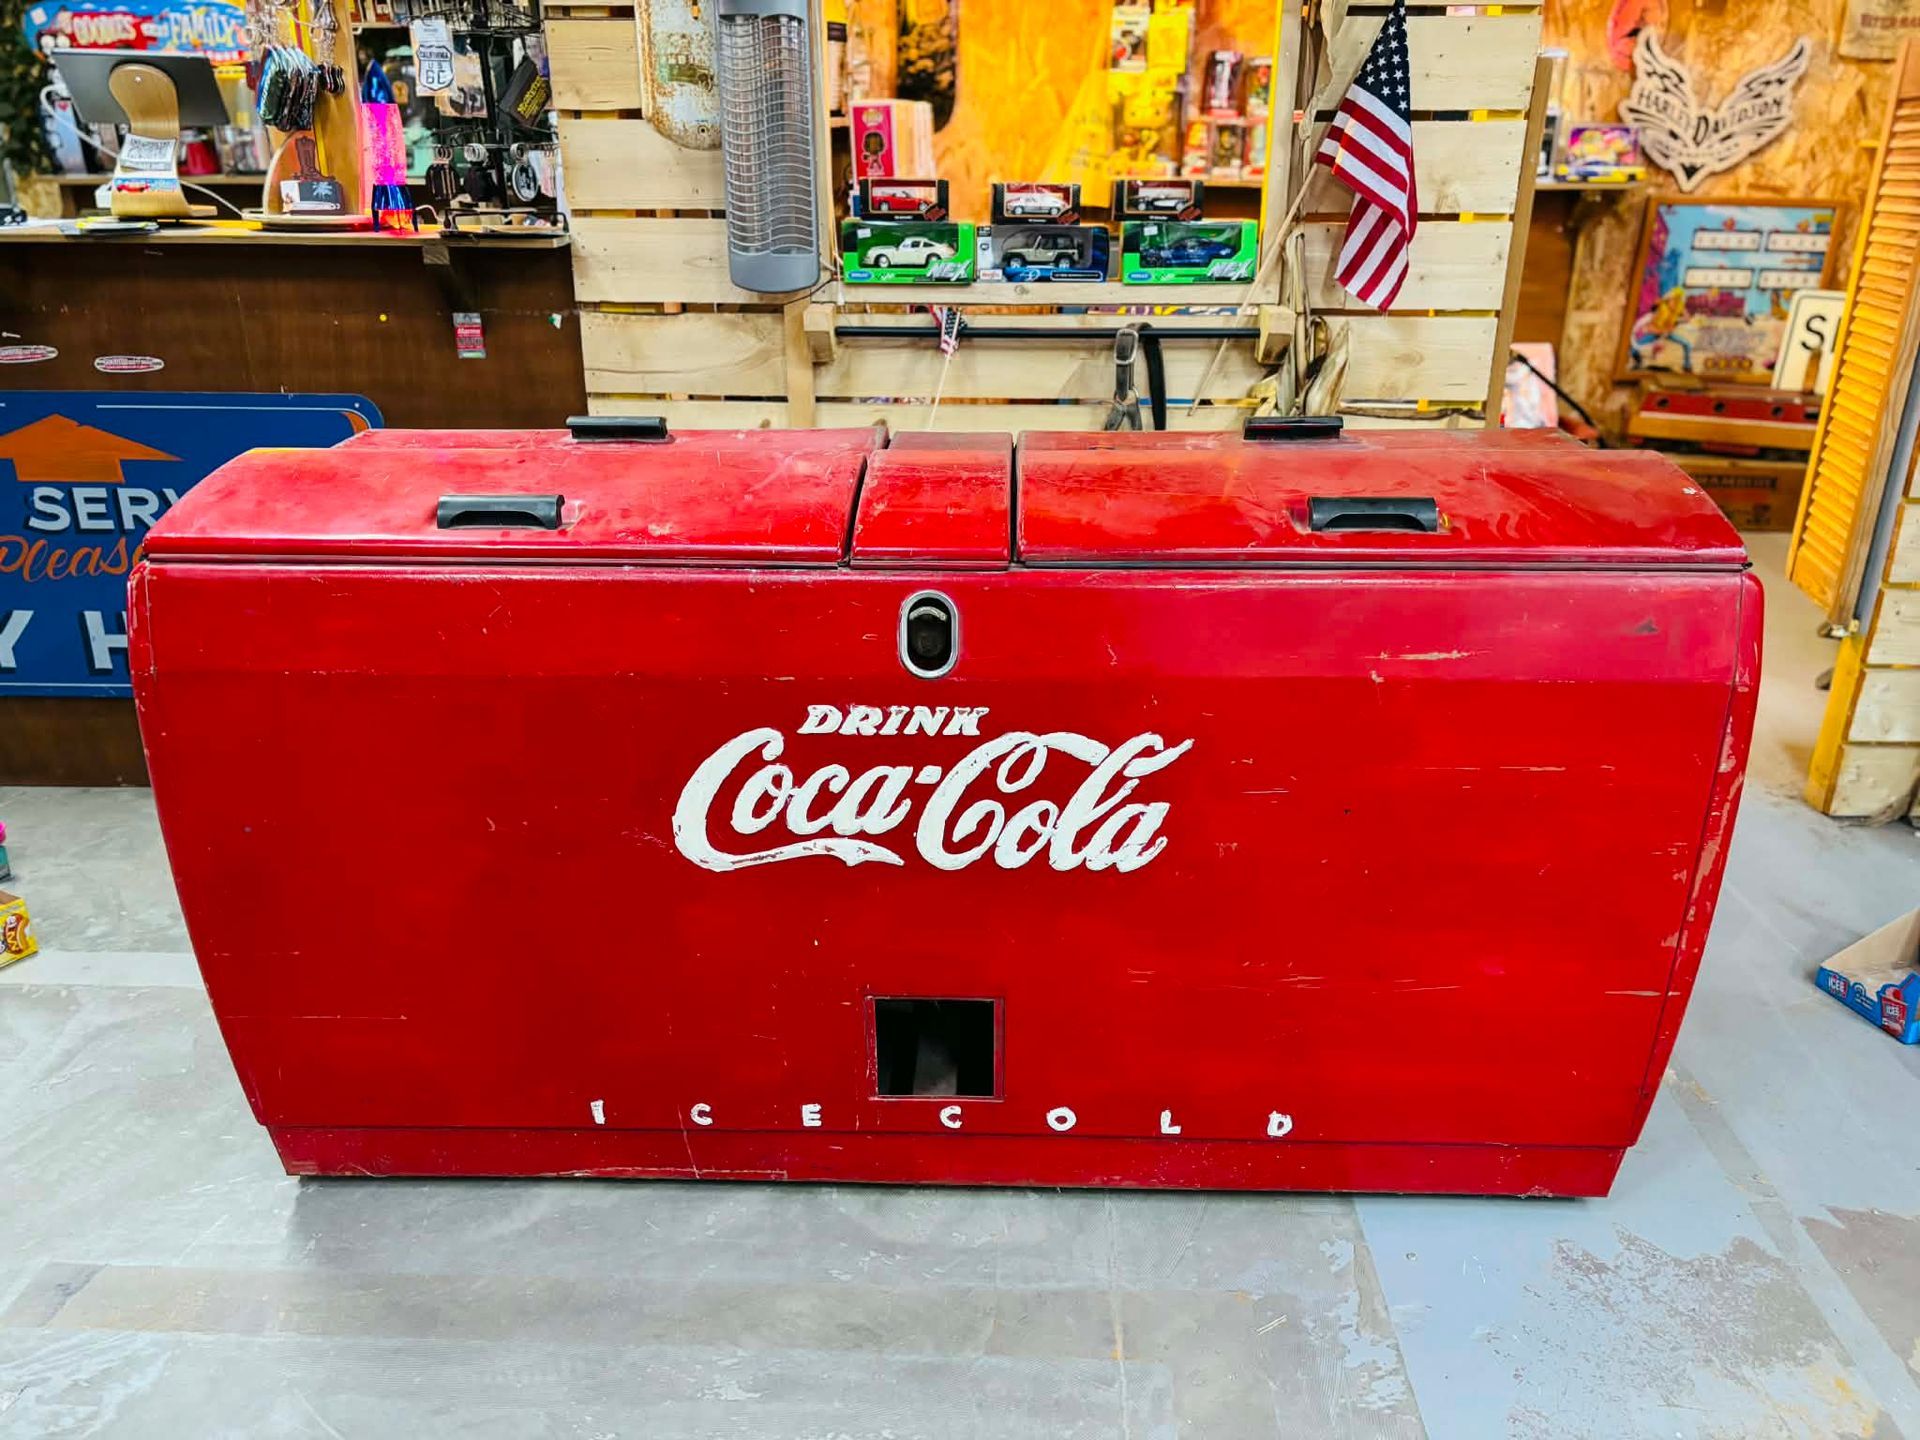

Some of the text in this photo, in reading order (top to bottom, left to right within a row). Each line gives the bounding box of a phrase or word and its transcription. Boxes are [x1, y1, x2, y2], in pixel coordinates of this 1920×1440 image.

[1801, 314, 1842, 353] S
[797, 704, 989, 735] DRINK
[672, 727, 1195, 872] Coca-Cola
